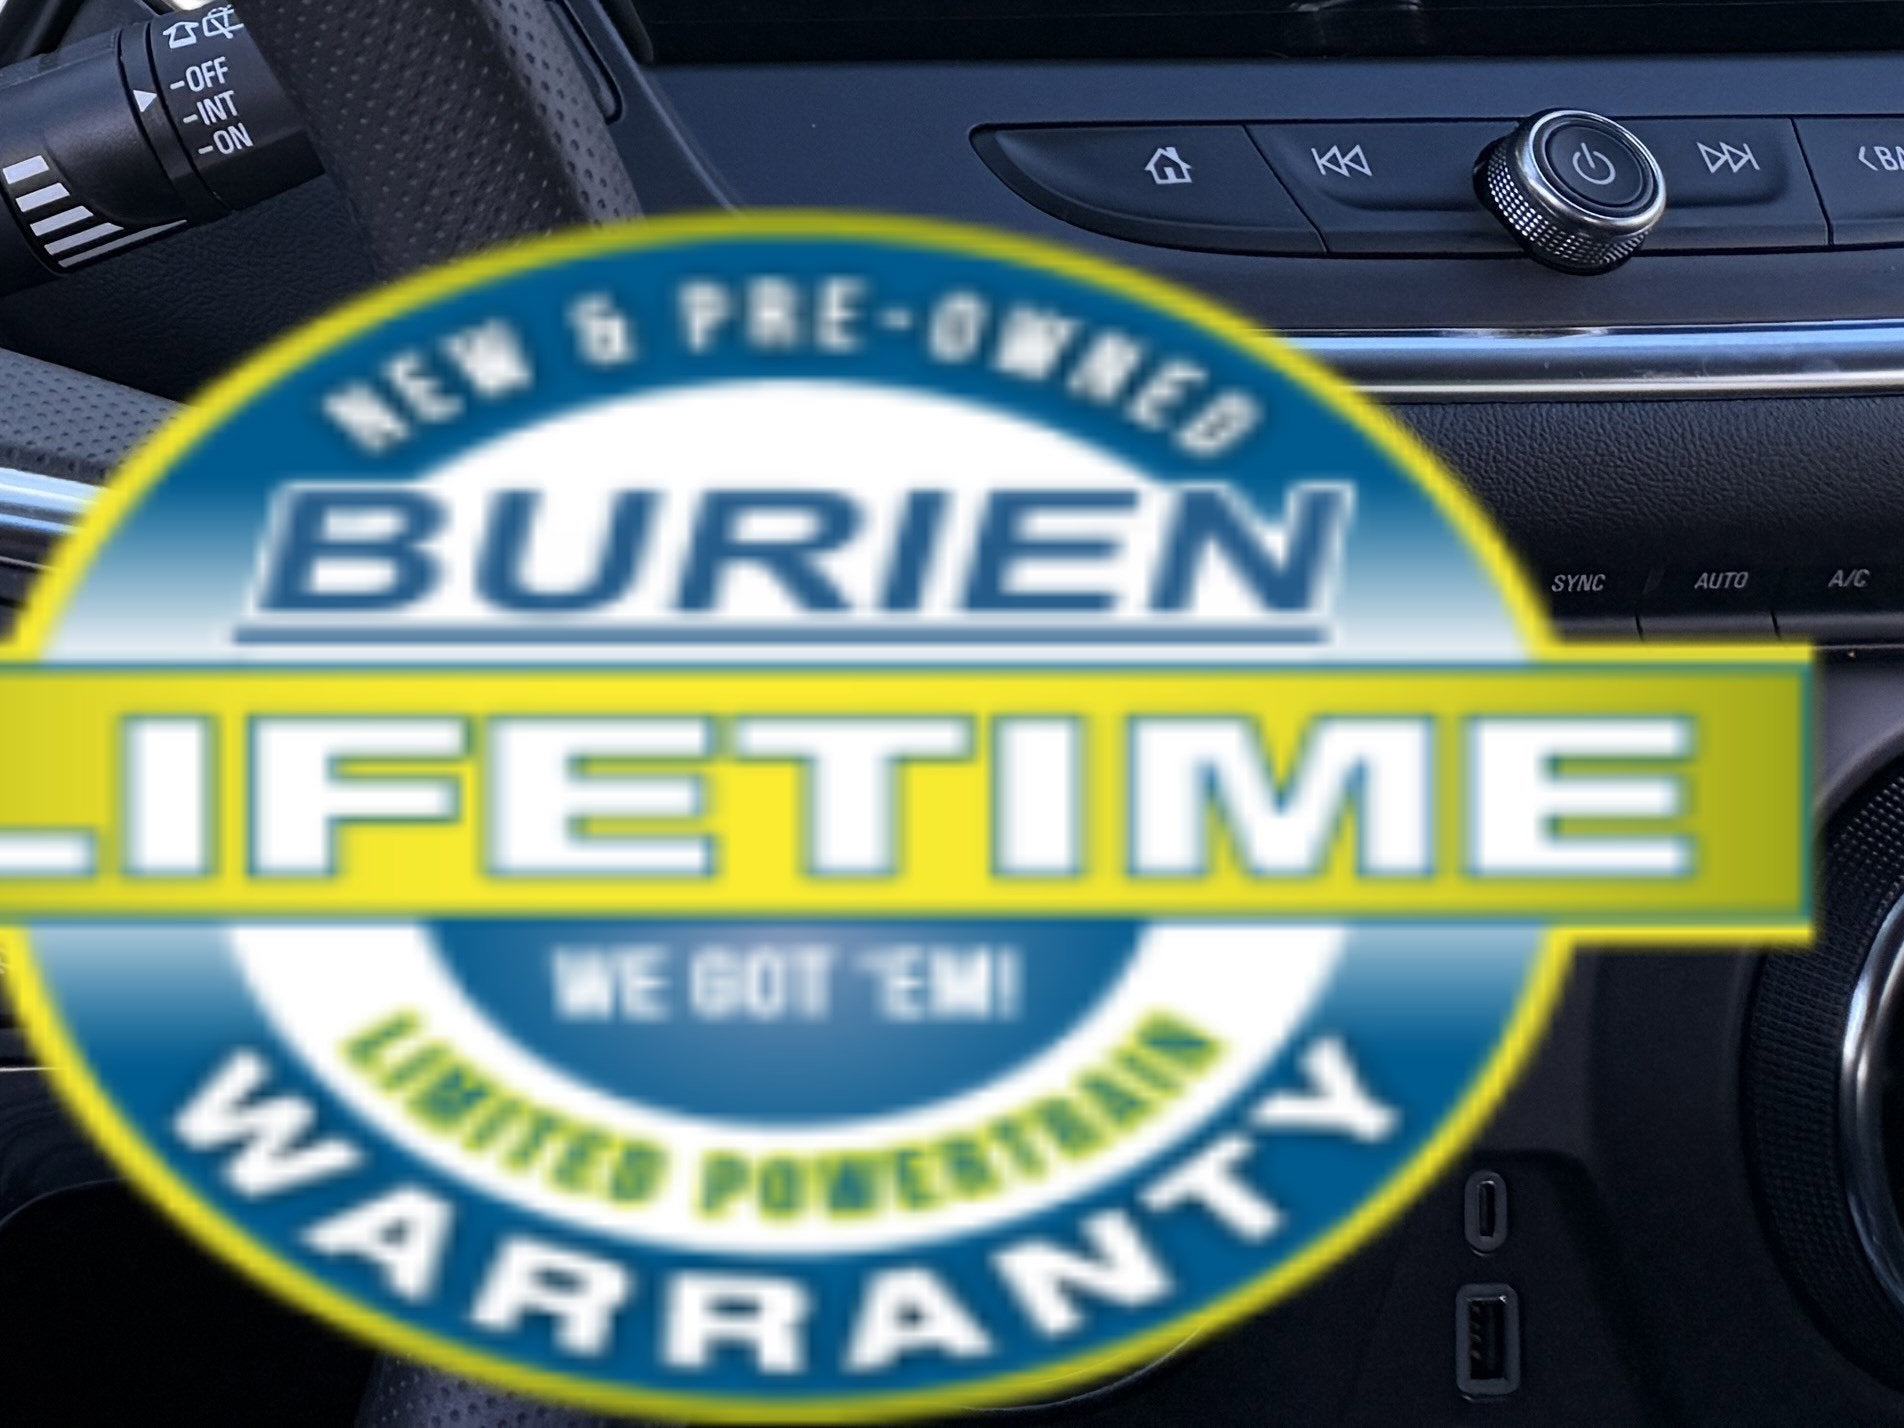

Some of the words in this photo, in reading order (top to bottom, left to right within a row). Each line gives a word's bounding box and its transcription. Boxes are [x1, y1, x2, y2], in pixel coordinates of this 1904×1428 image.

[1551, 573, 1606, 593] SYNC
[1694, 571, 1749, 591] AUTO
[1828, 568, 1872, 589] A/C
